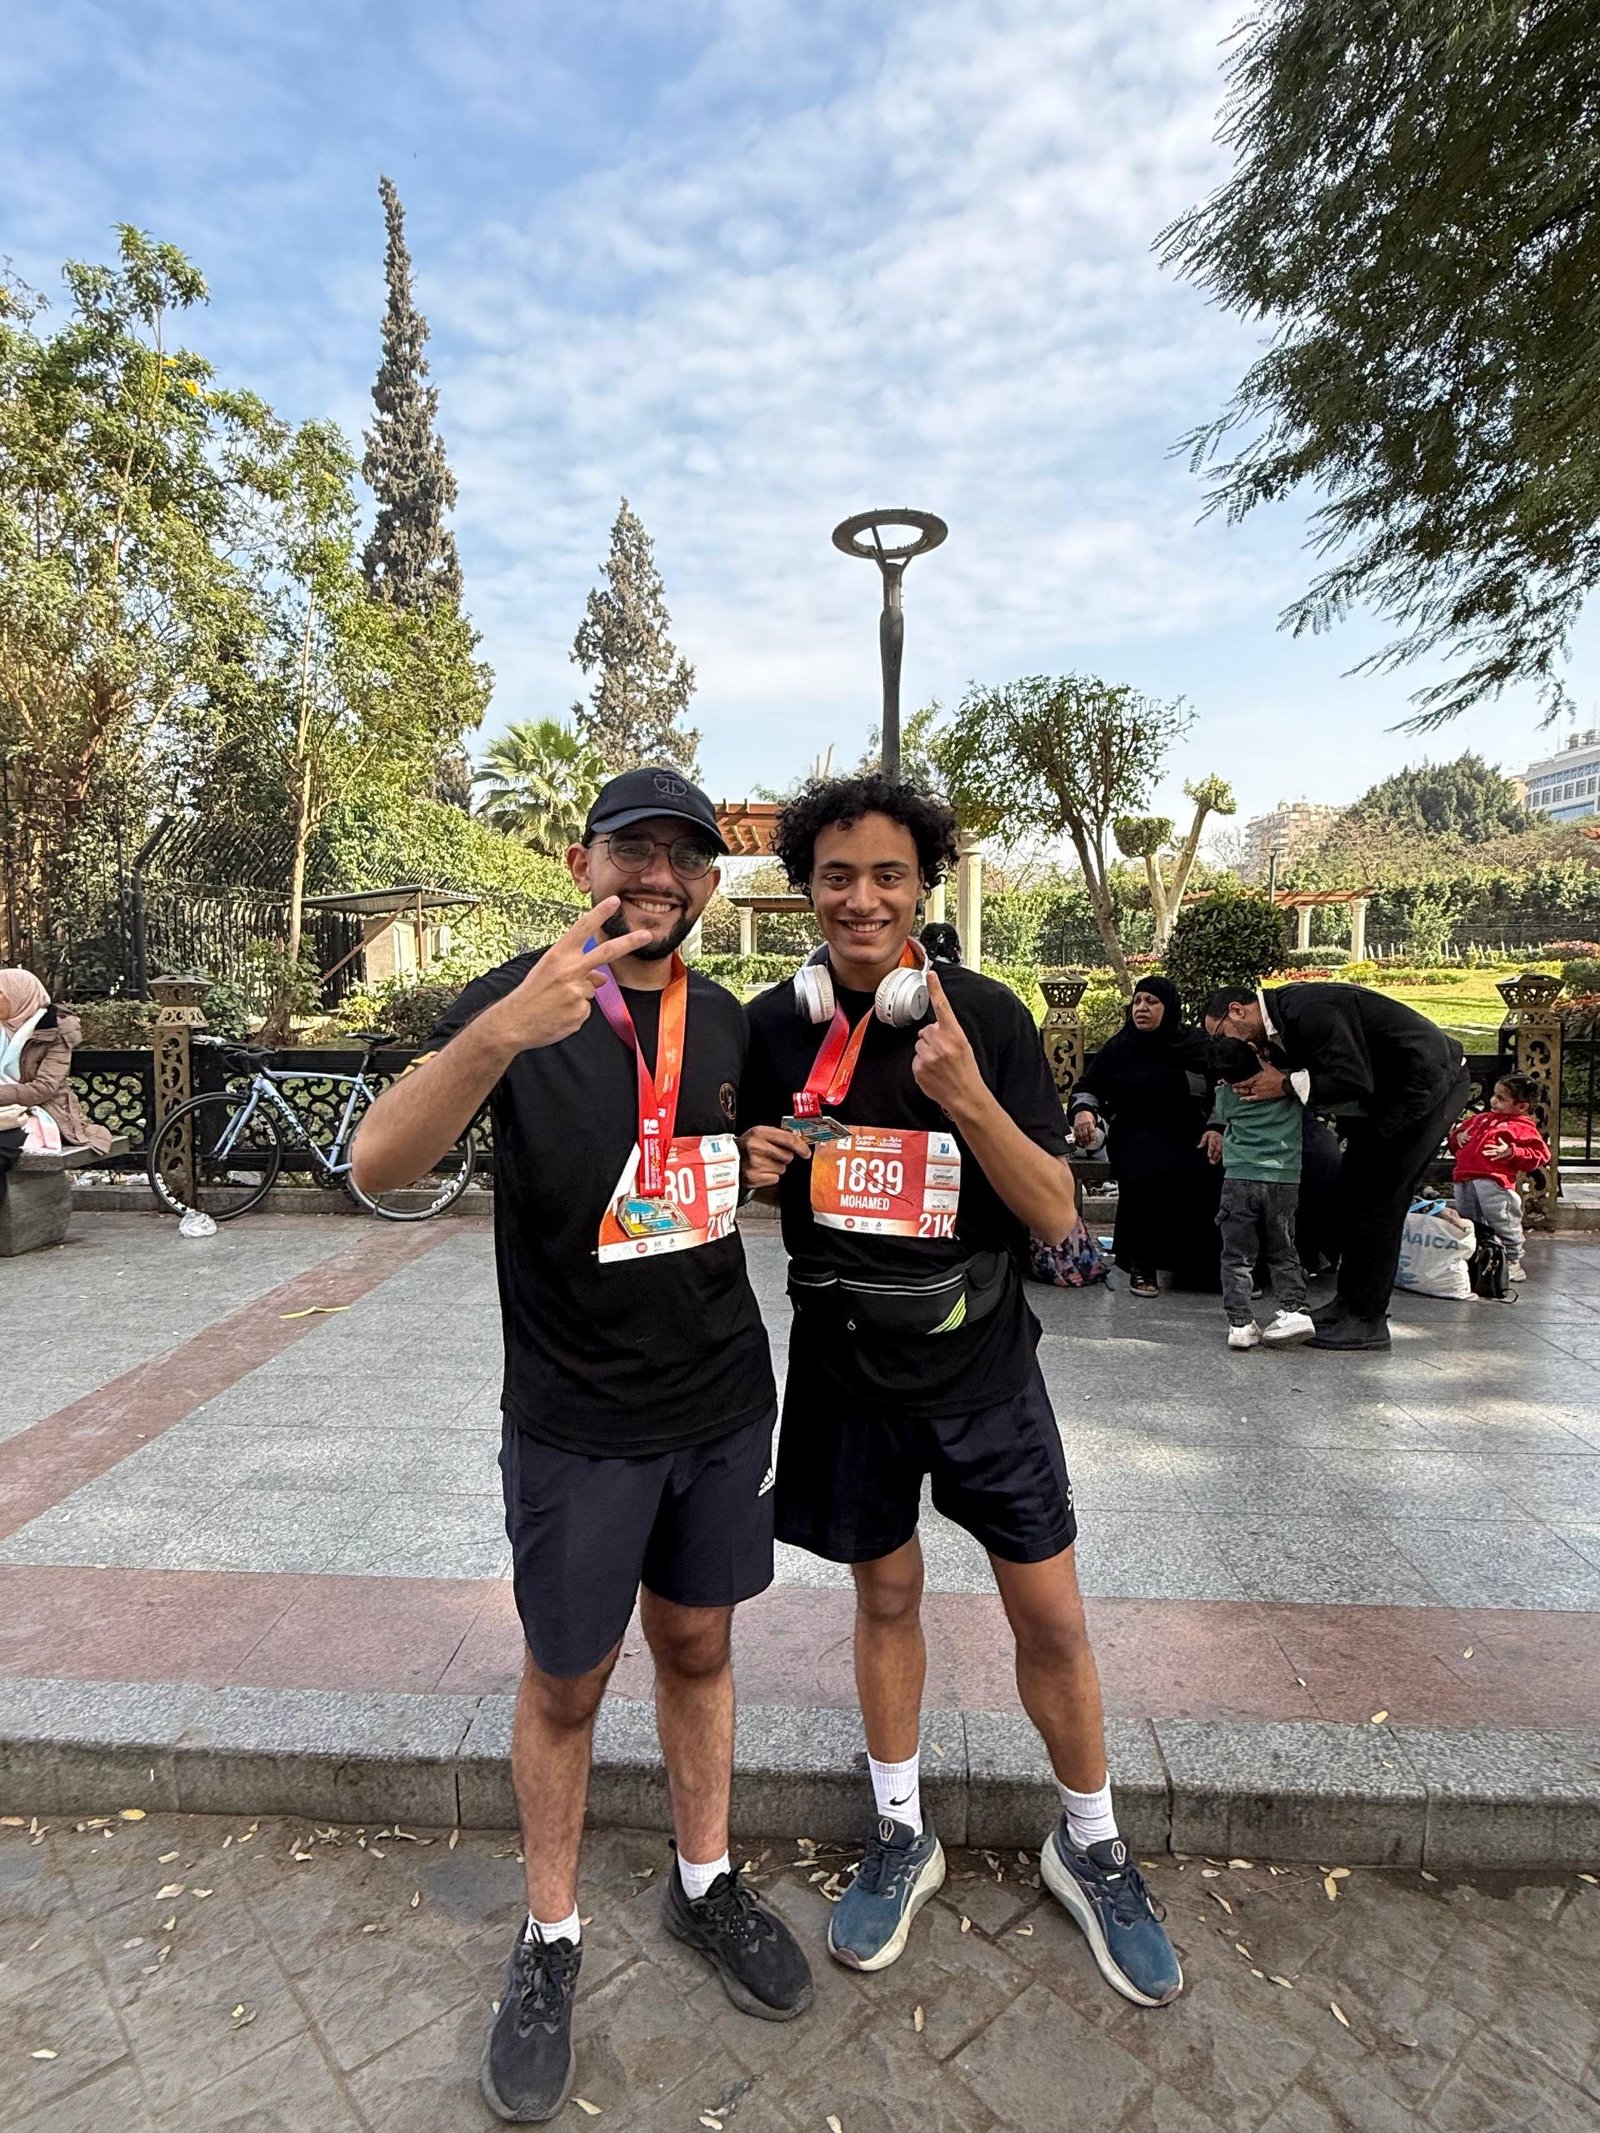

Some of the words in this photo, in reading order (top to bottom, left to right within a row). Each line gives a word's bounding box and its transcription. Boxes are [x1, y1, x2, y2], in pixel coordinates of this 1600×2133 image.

[836, 1156, 904, 1196] 1839
[840, 1194, 890, 1211] MOHAMED
[917, 1212, 957, 1239] 21K
